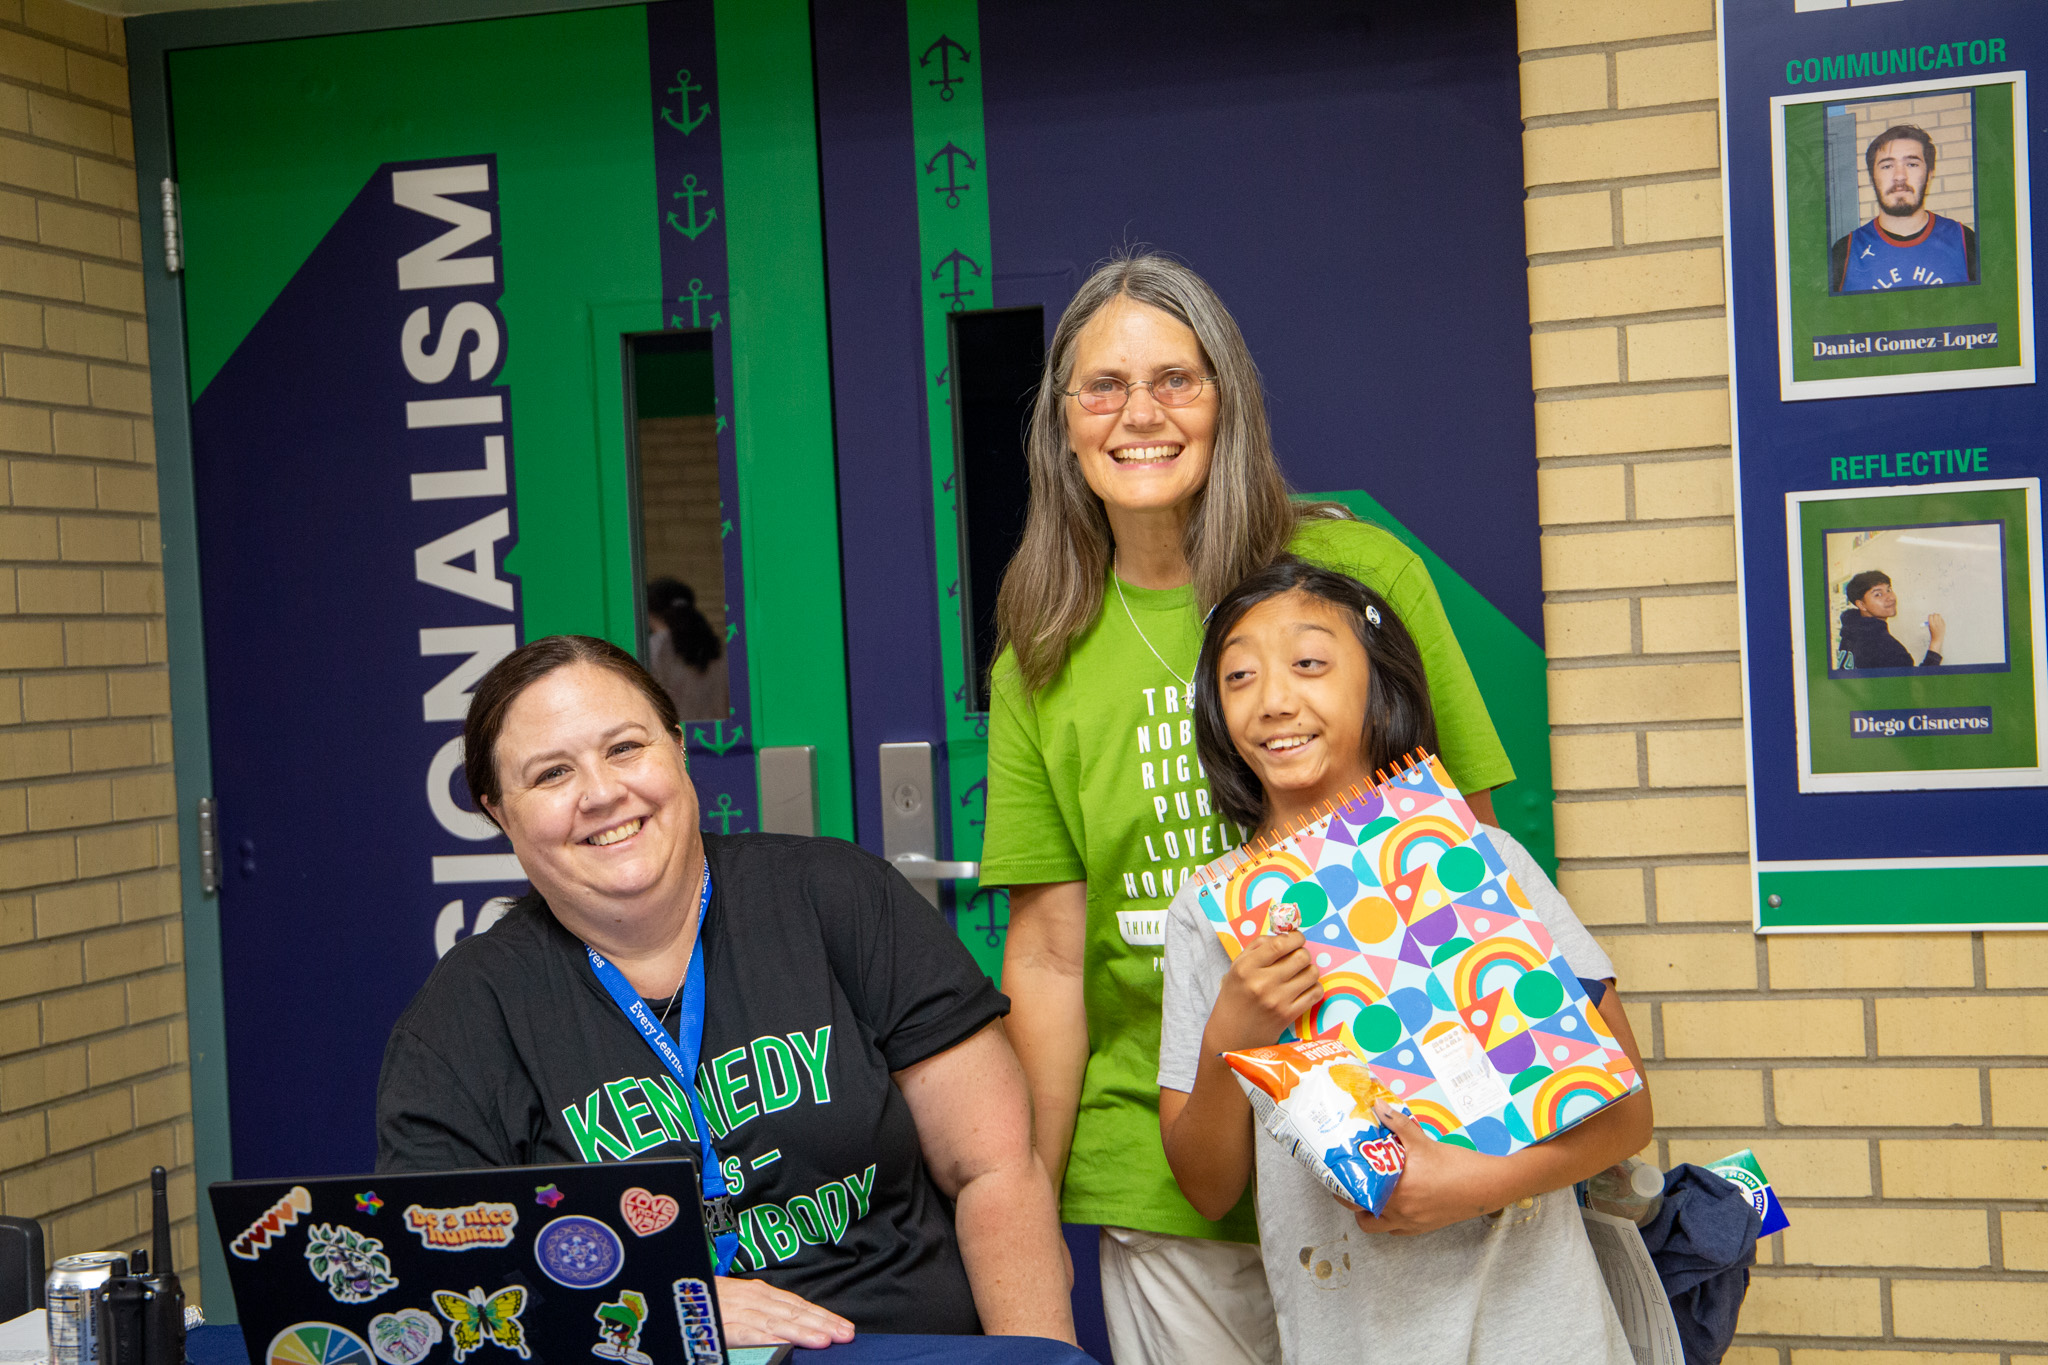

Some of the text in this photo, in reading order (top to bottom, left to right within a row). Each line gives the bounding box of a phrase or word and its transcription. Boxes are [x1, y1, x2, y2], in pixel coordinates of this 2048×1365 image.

[1786, 37, 2007, 85] COMMUNICATOR
[1872, 267, 1902, 290] LE
[1812, 331, 1998, 358] Daniel Gomez-Lopez
[1830, 447, 1989, 481] REFLECTIVE
[1853, 713, 1989, 737] Diego Cisneros
[1123, 865, 1205, 899] HONO
[1125, 920, 1160, 936] THINK
[629, 1000, 685, 1078] Every Learne
[562, 1025, 832, 1163] KENNEDY
[1728, 1171, 1756, 1188] HIGH
[408, 1206, 513, 1230] be a nice
[425, 1224, 507, 1247] human
